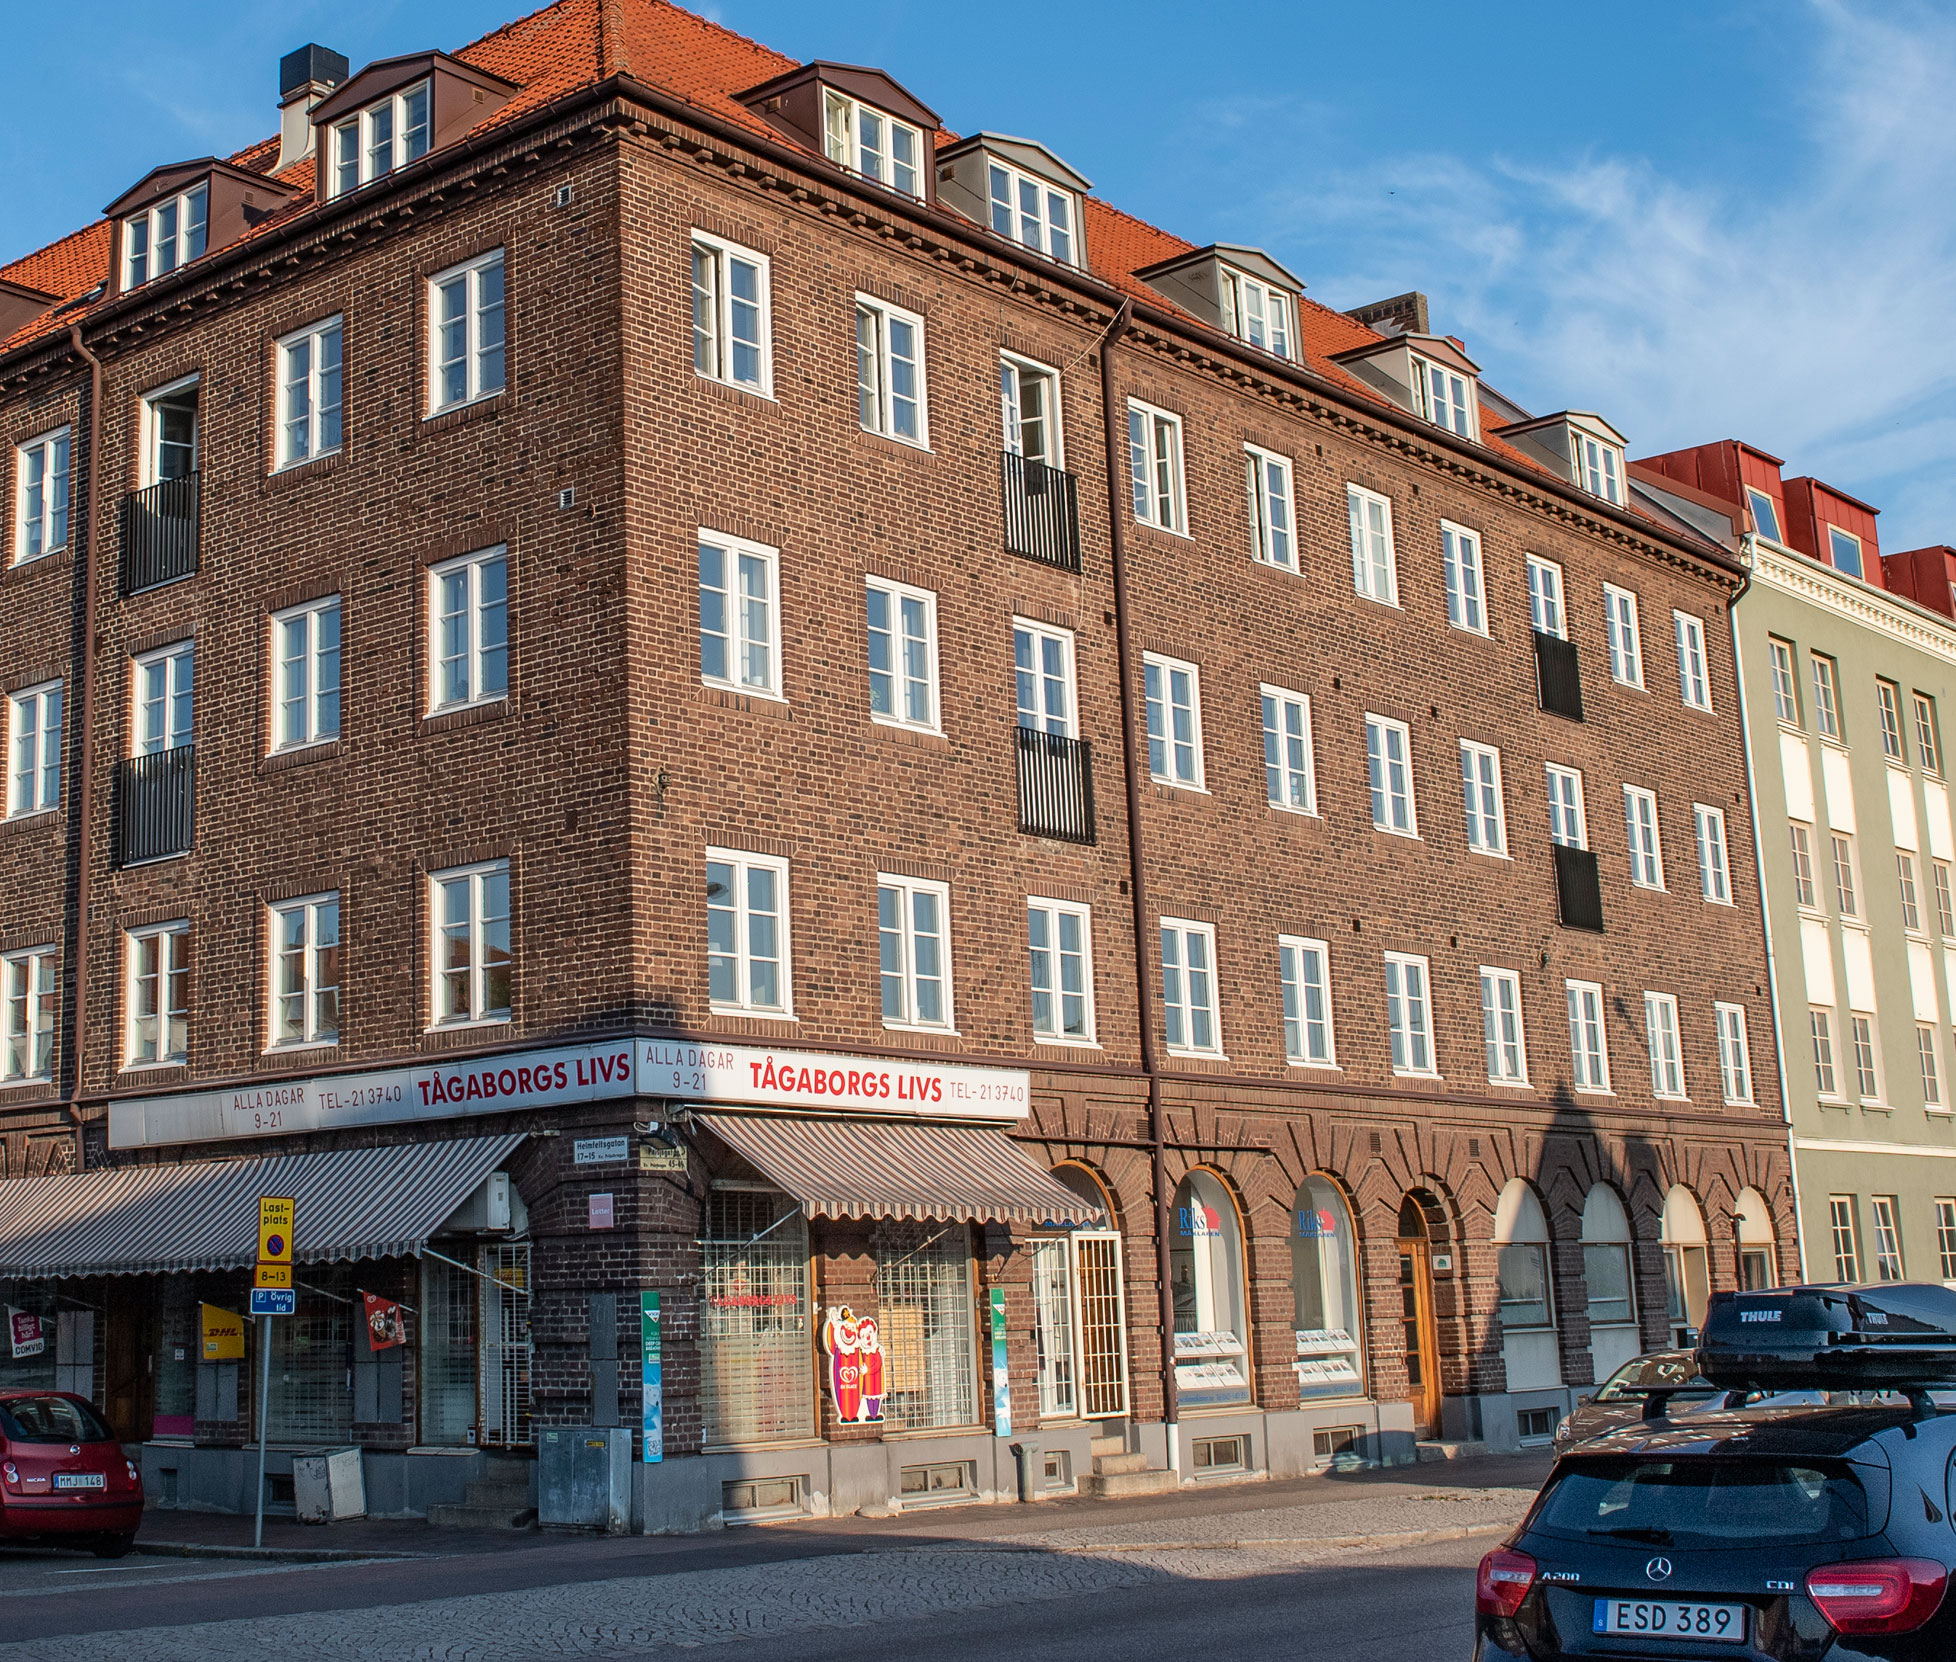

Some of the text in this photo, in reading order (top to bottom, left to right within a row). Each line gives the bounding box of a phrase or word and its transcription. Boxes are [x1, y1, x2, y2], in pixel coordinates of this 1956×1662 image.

[646, 1045, 734, 1071] ALLA DAGAR
[418, 1053, 630, 1106] TÅGABORGS LIVS
[673, 1071, 706, 1091] 9-21
[750, 1055, 942, 1102] TÅGABORGS LIVS
[233, 1087, 305, 1111] ALLA DAGAR
[254, 1110, 282, 1129] 9-21
[264, 1202, 290, 1213] Last-
[263, 1215, 289, 1226] plats
[1178, 1207, 1206, 1230] Riks
[1298, 1209, 1322, 1230] Riks
[261, 1271, 286, 1281] 8-13
[270, 1291, 292, 1303] Övrig
[276, 1303, 286, 1312] tid
[1740, 1310, 1783, 1323] THULE
[1866, 1312, 1888, 1325] THULE
[208, 1327, 238, 1337] DHL
[60, 1476, 101, 1487] MMJ 148
[1766, 1580, 1795, 1591] CDI
[1616, 1603, 1666, 1631] ESD
[1676, 1606, 1731, 1635] 389
